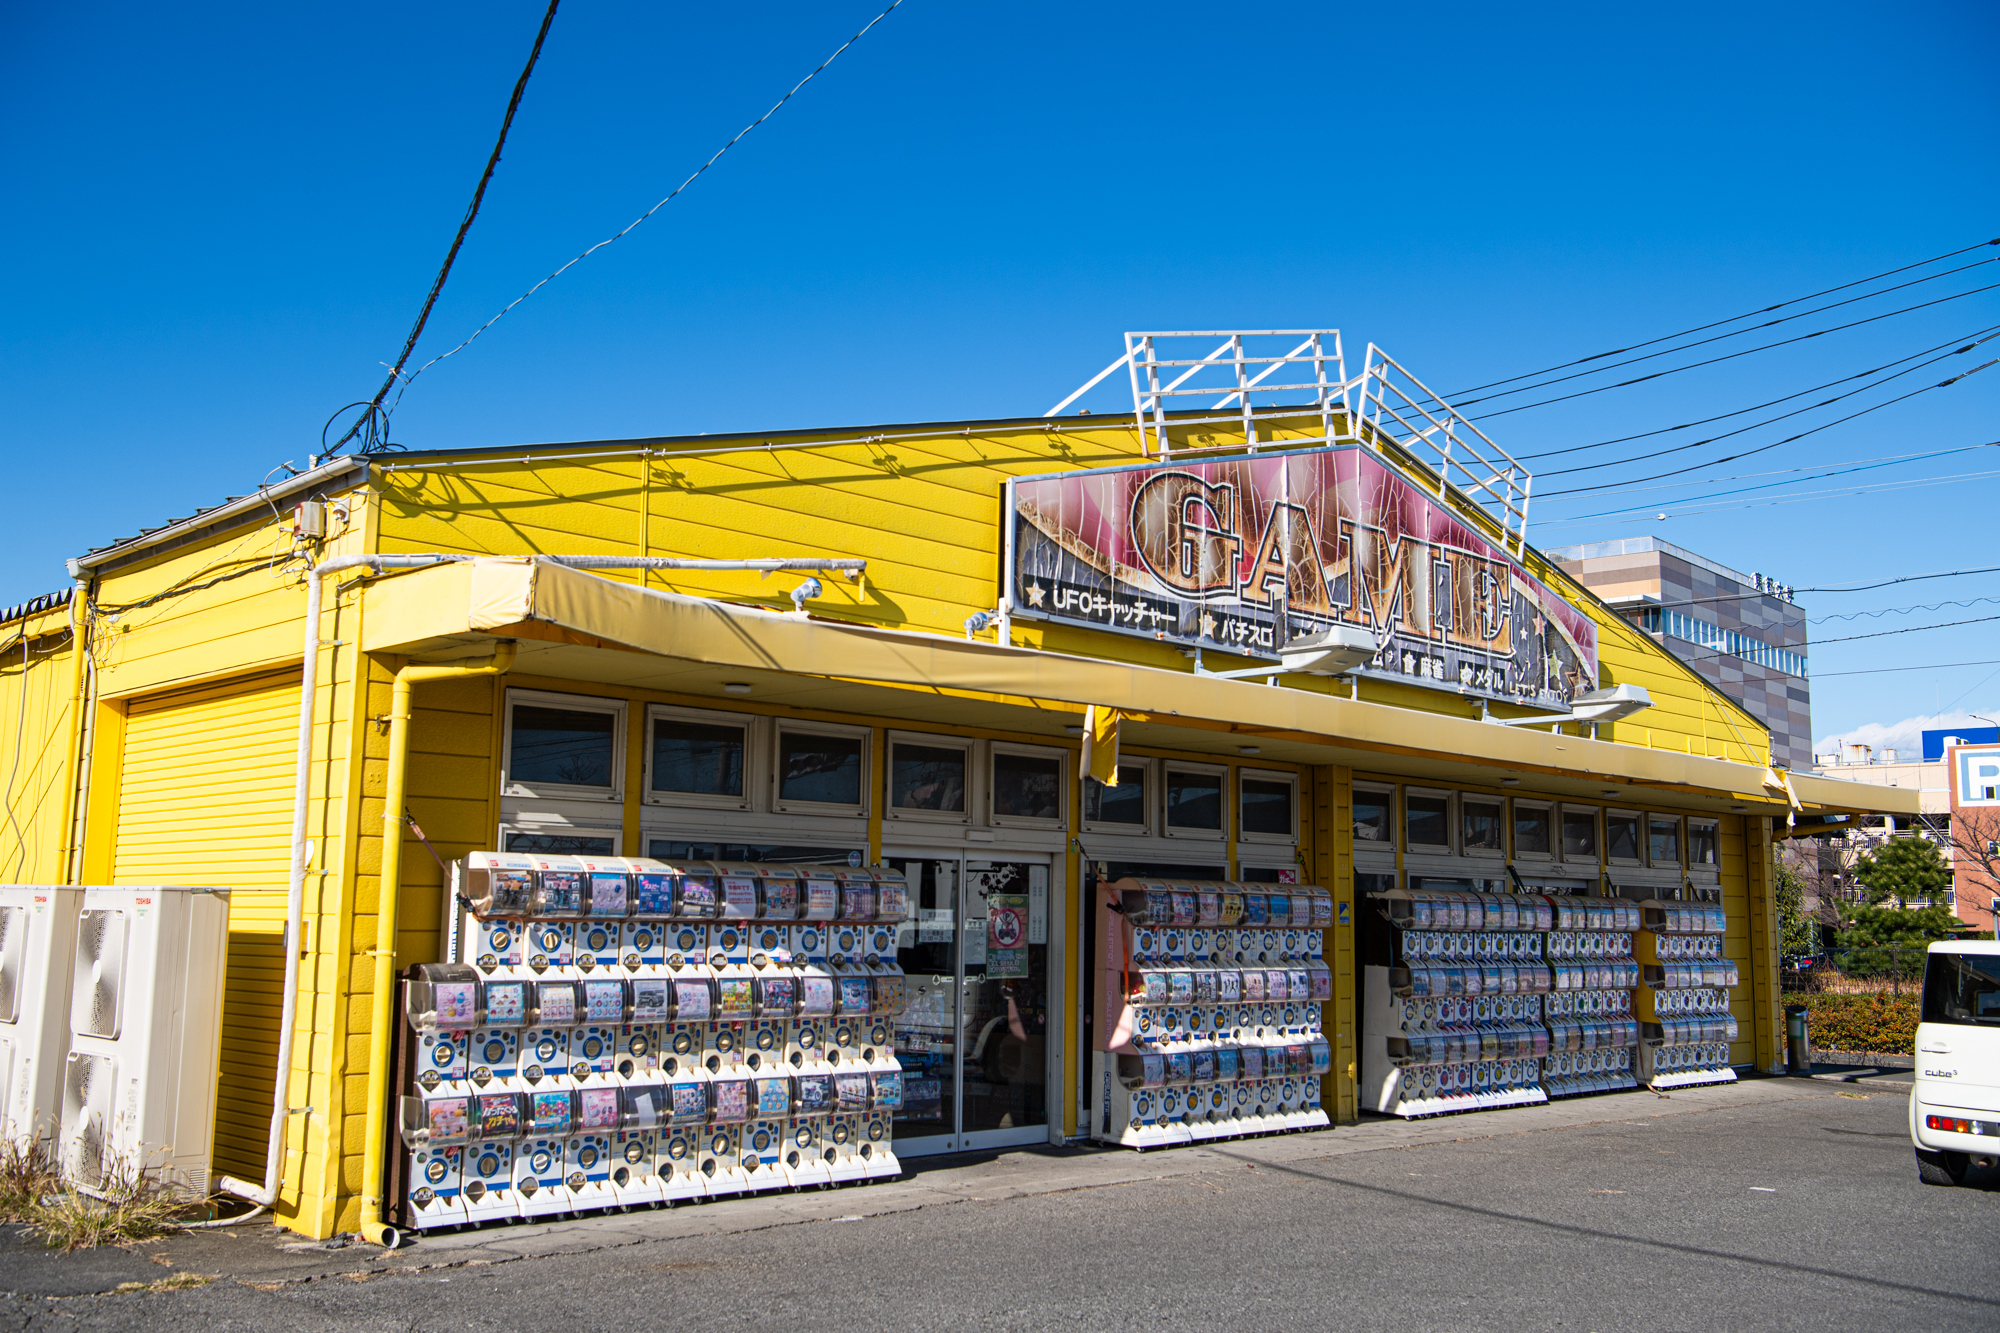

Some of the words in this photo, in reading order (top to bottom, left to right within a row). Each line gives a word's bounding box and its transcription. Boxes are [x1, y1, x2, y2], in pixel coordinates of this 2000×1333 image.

[1053, 587, 1177, 626] UFOキャッチャー
[1221, 617, 1274, 648] パチスロ
[1420, 656, 1444, 680] 麻雀
[135, 897, 151, 905] TOSHIBA
